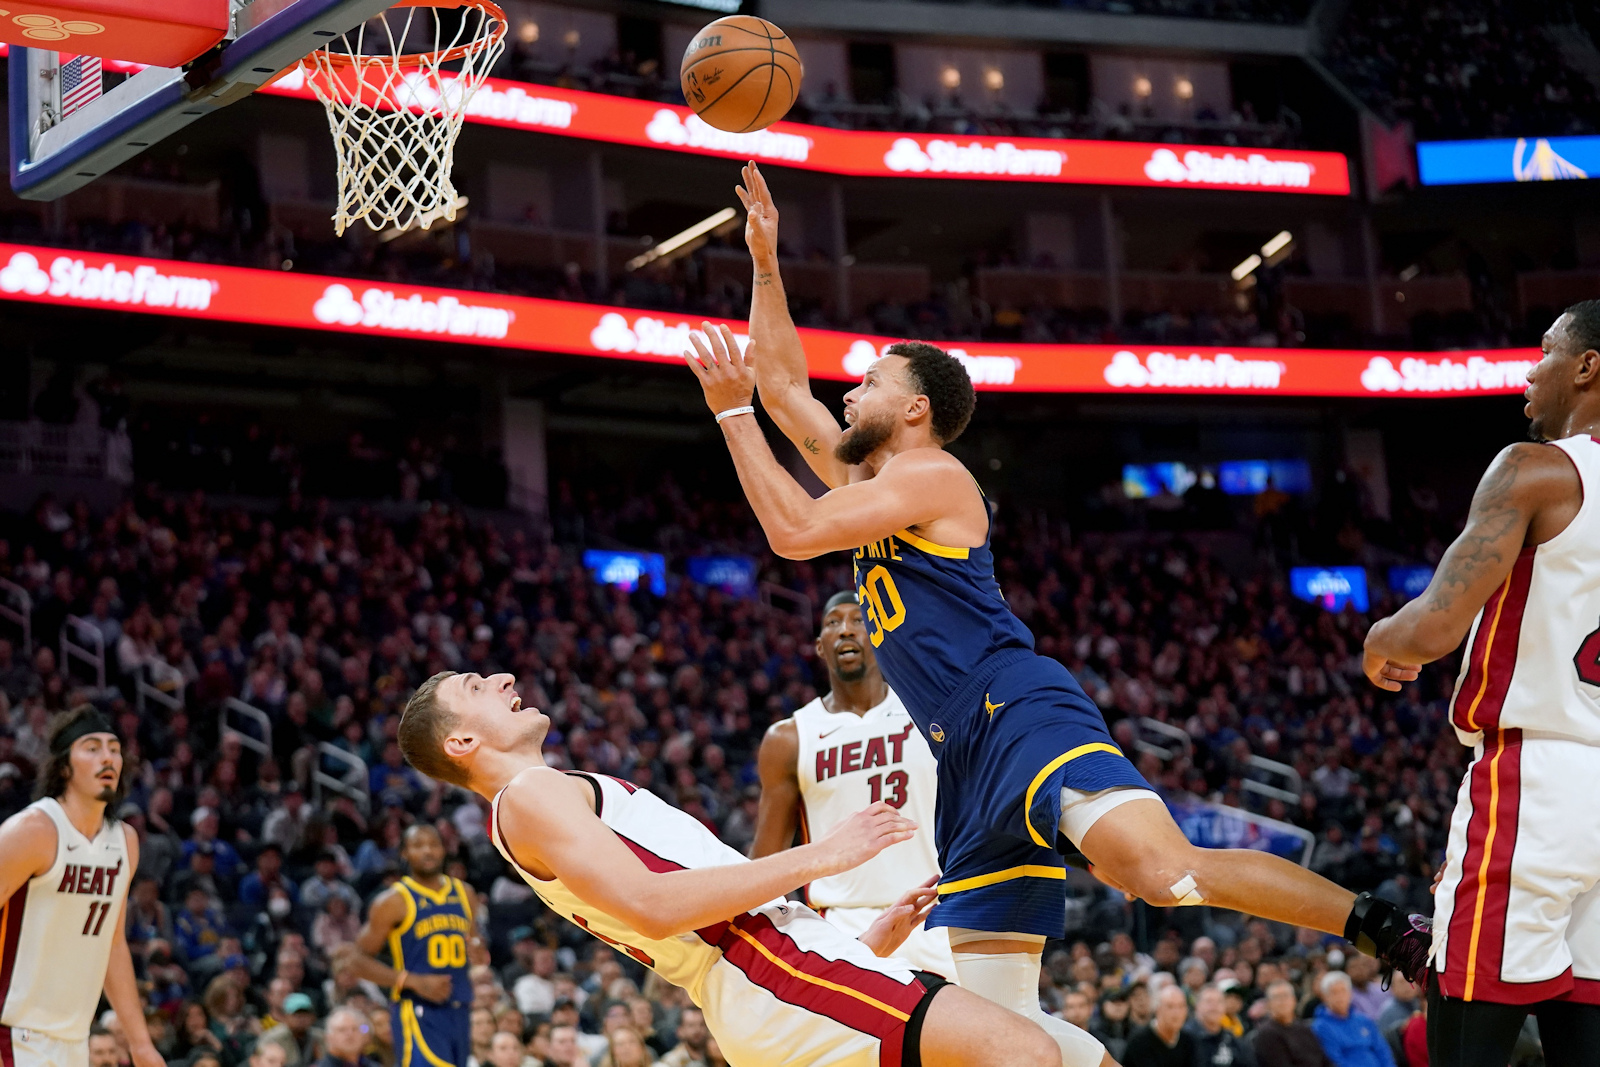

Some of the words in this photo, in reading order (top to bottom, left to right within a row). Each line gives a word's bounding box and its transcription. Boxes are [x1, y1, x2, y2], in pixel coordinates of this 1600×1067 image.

[858, 564, 906, 649] 30
[815, 721, 914, 783] HEAT
[867, 769, 909, 810] 13
[57, 856, 122, 896] HEAT
[82, 901, 111, 936] 11
[427, 933, 467, 969] 00
